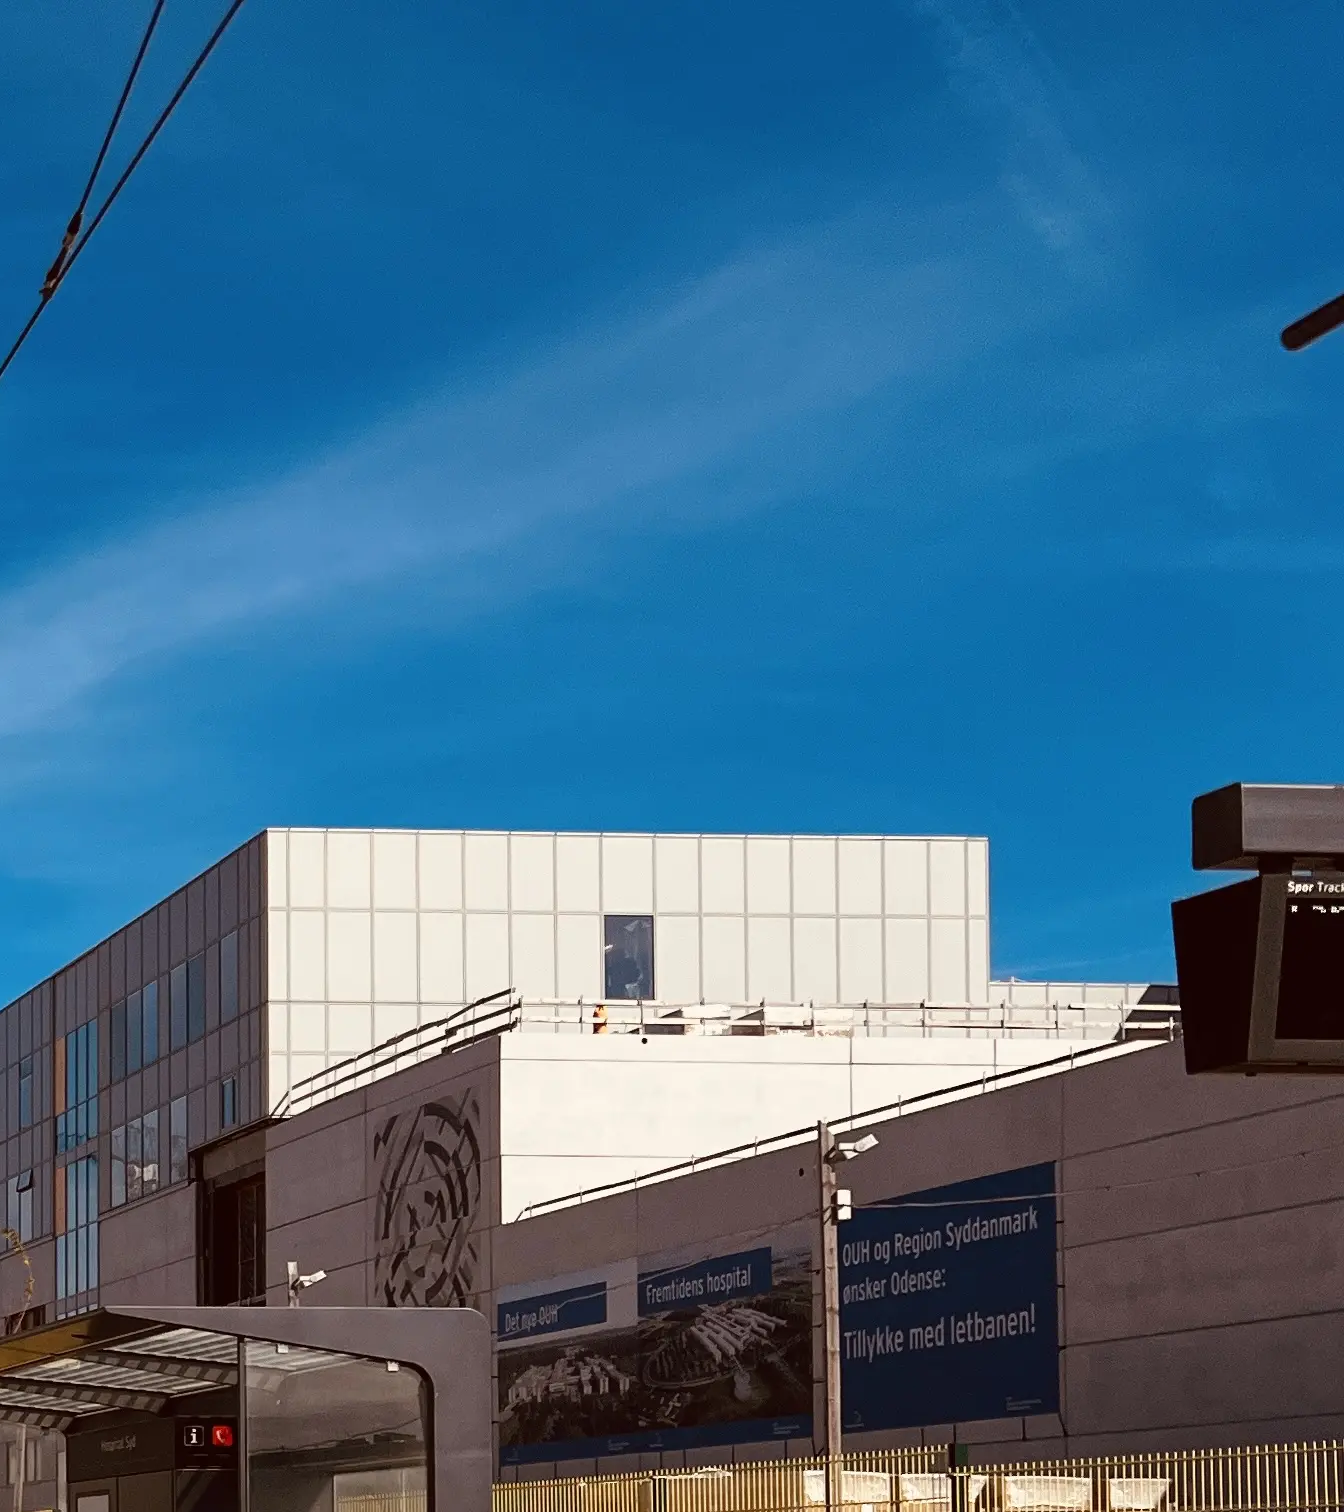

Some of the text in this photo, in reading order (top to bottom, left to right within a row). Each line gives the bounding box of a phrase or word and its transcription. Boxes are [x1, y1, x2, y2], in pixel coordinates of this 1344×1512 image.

[1288, 881, 1314, 894] Spor
[843, 1205, 1038, 1267] OUH og Region Syddanmark
[646, 1264, 751, 1304] Fremtidens hospital
[843, 1269, 946, 1304] ønsker Odense:
[505, 1312, 520, 1332] Det
[844, 1303, 1036, 1363] Tillykke med letbanen!
